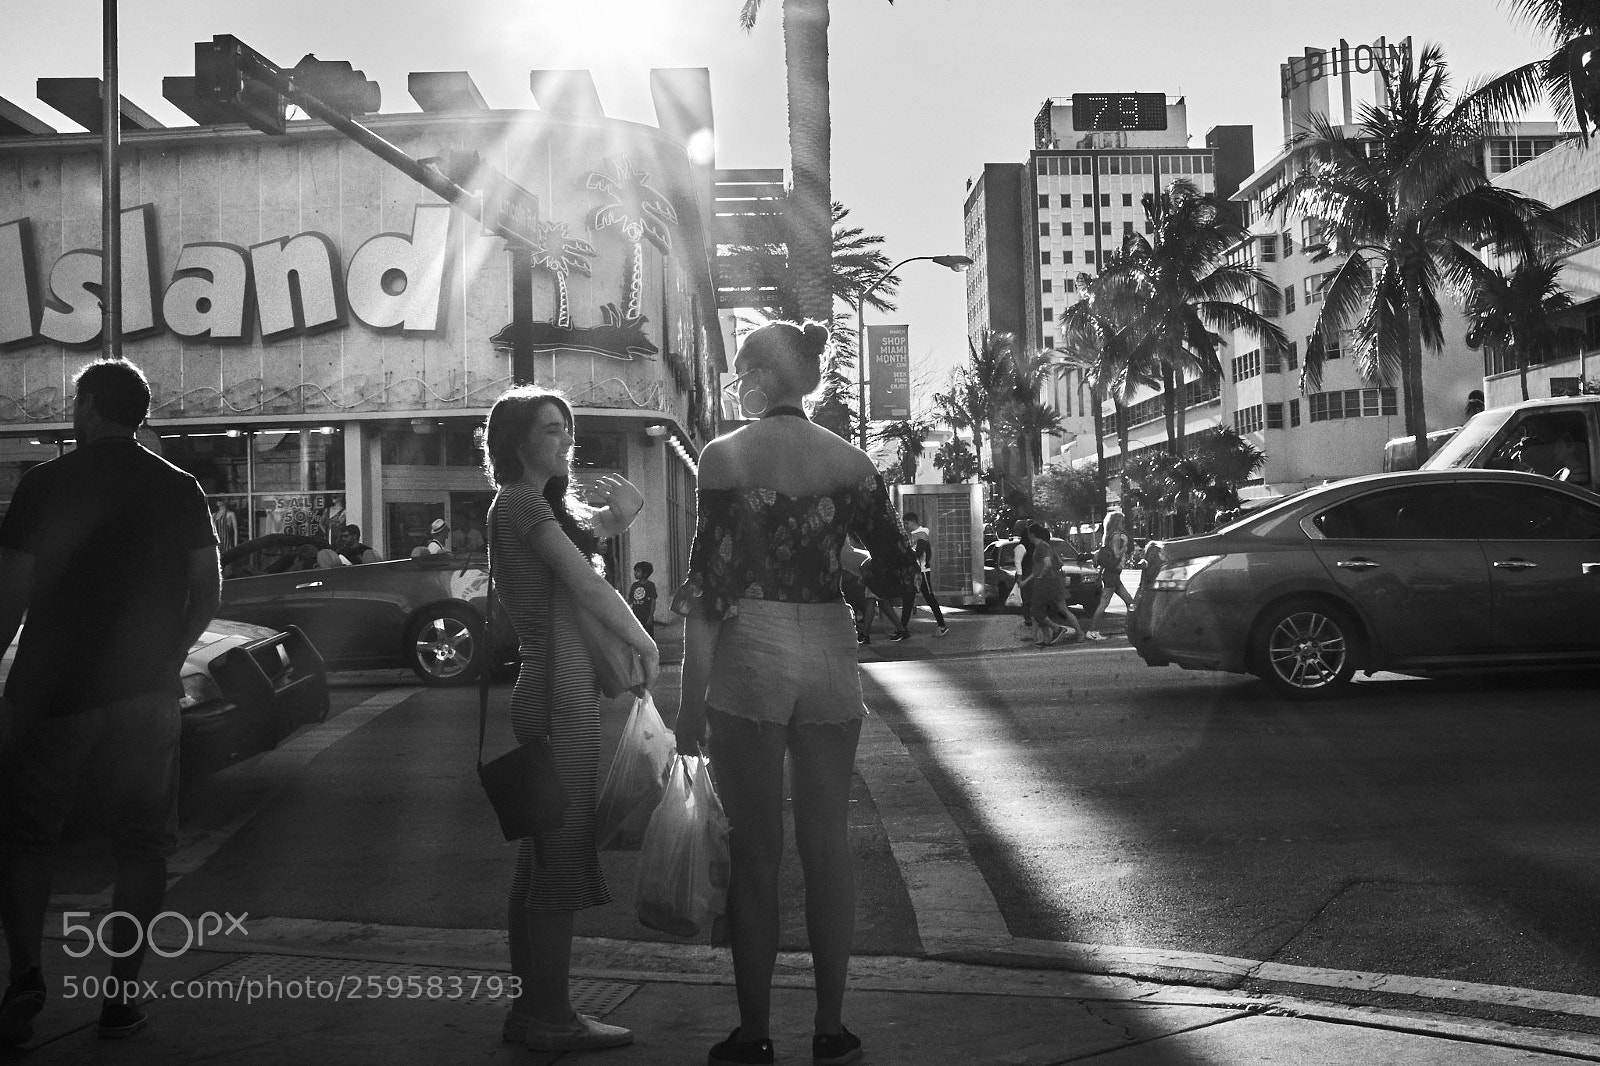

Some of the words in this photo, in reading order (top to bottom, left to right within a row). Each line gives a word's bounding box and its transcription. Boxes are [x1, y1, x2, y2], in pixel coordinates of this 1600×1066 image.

[1088, 97, 1139, 129] 79
[0, 203, 450, 351] Island
[882, 337, 906, 346] SHOP
[880, 346, 907, 354] MIAMI
[876, 354, 907, 363] MONTH
[276, 497, 325, 509] SALE
[284, 510, 322, 523] 50%
[284, 524, 319, 536] OFF
